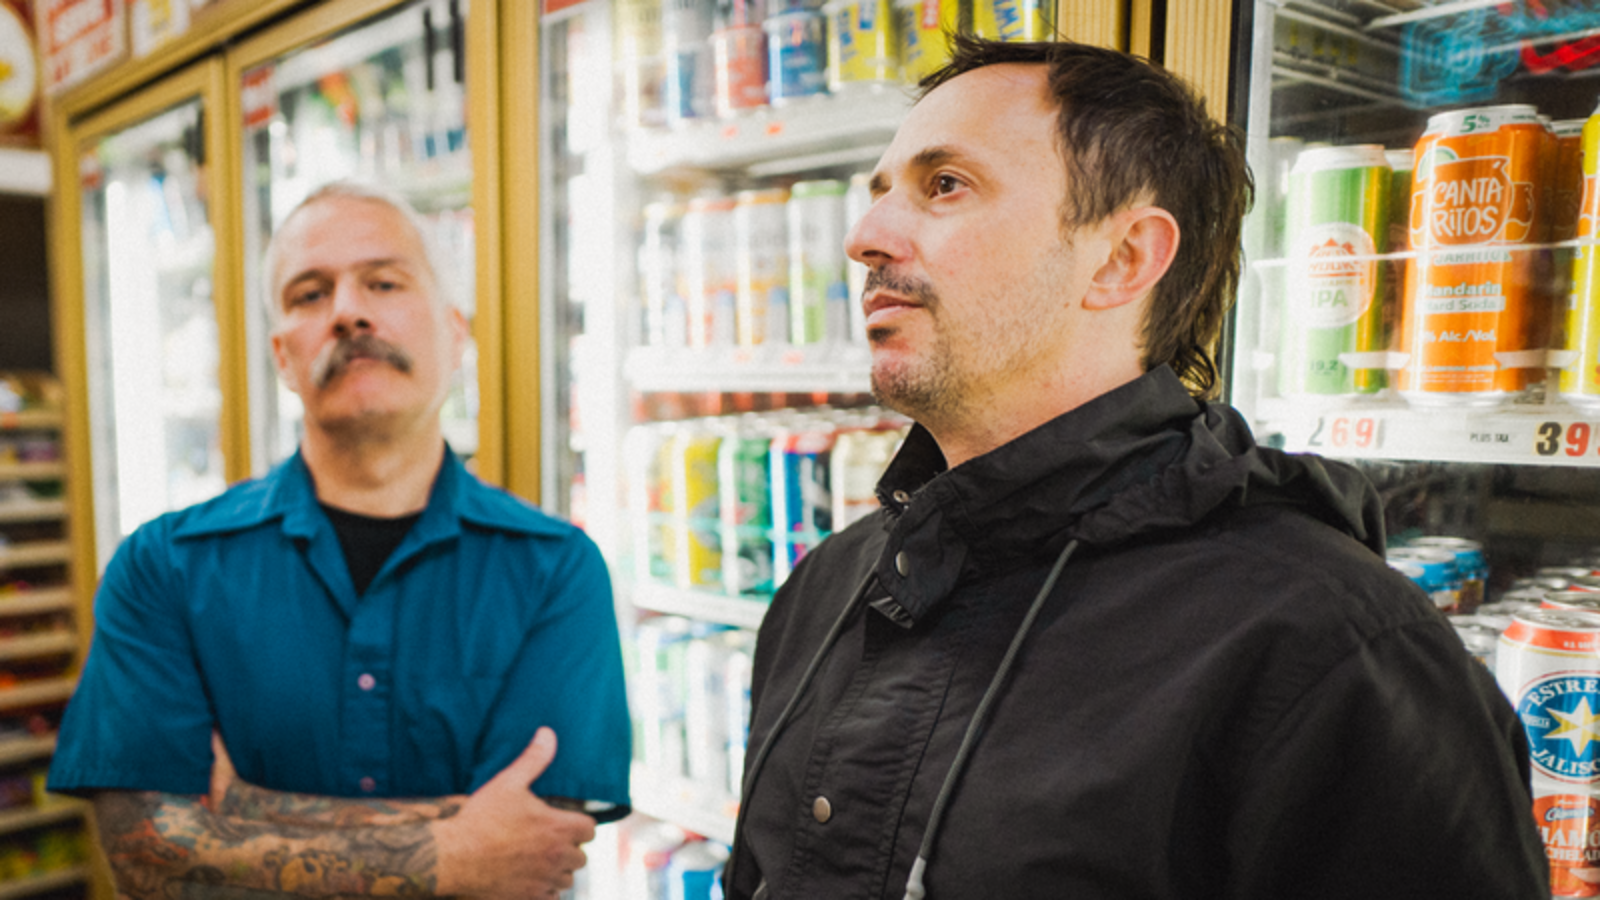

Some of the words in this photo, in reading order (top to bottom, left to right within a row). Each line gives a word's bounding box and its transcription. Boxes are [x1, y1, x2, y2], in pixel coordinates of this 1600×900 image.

[1433, 177, 1504, 208] CANTA
[1310, 289, 1349, 308] IPA
[1459, 299, 1497, 311] Soda
[1536, 421, 1600, 457] 39
[1527, 679, 1600, 706] ESTRE
